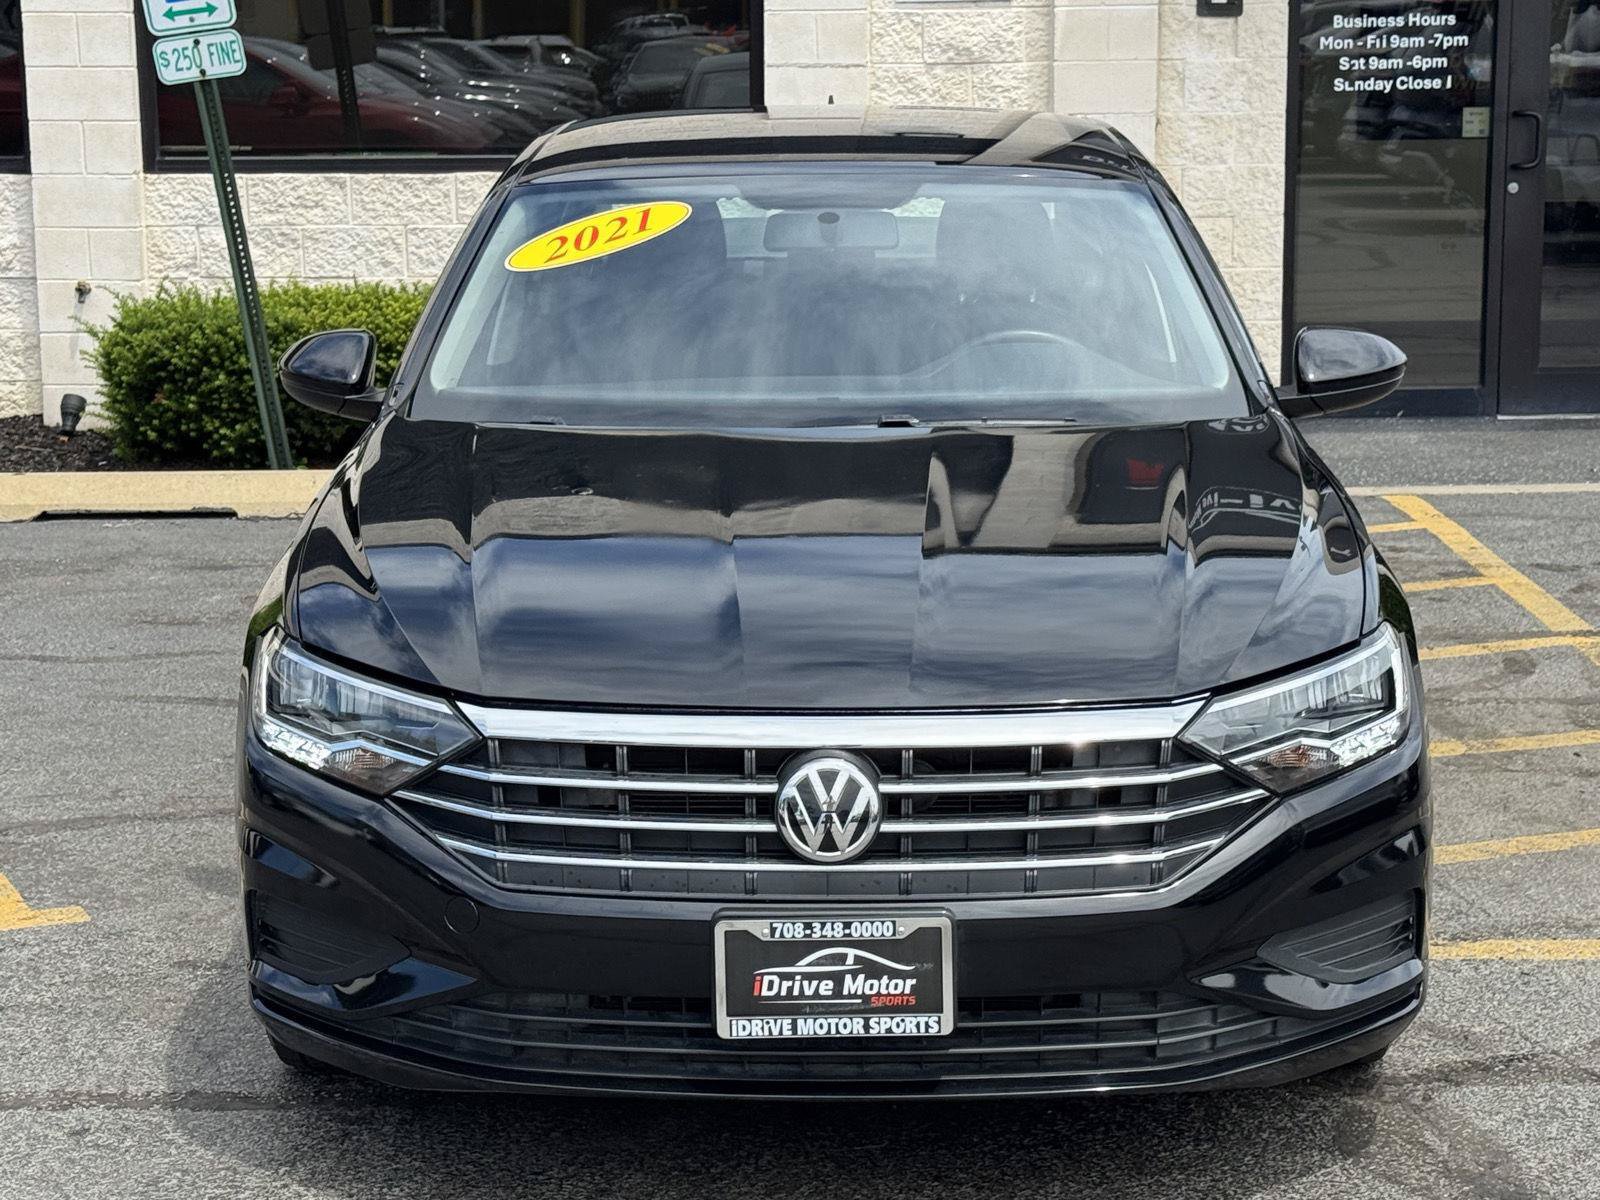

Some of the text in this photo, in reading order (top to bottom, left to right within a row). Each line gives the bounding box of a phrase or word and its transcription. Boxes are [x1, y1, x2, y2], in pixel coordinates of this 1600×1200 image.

[1333, 12, 1457, 29] Business Hours
[1319, 35, 1354, 50] Mon
[1389, 34, 1425, 48] 9am
[1427, 33, 1469, 50] -7pm
[159, 40, 240, 72] $250 FINE
[1368, 56, 1403, 70] 9am
[1406, 54, 1449, 71] -6pm
[544, 207, 653, 264] 2021
[772, 922, 894, 938] 708-348-0000
[752, 973, 917, 997] iDrive Motor
[870, 995, 917, 1008] SPORTS
[797, 1018, 865, 1035] MOTOR
[869, 1016, 940, 1034] SPORTS
